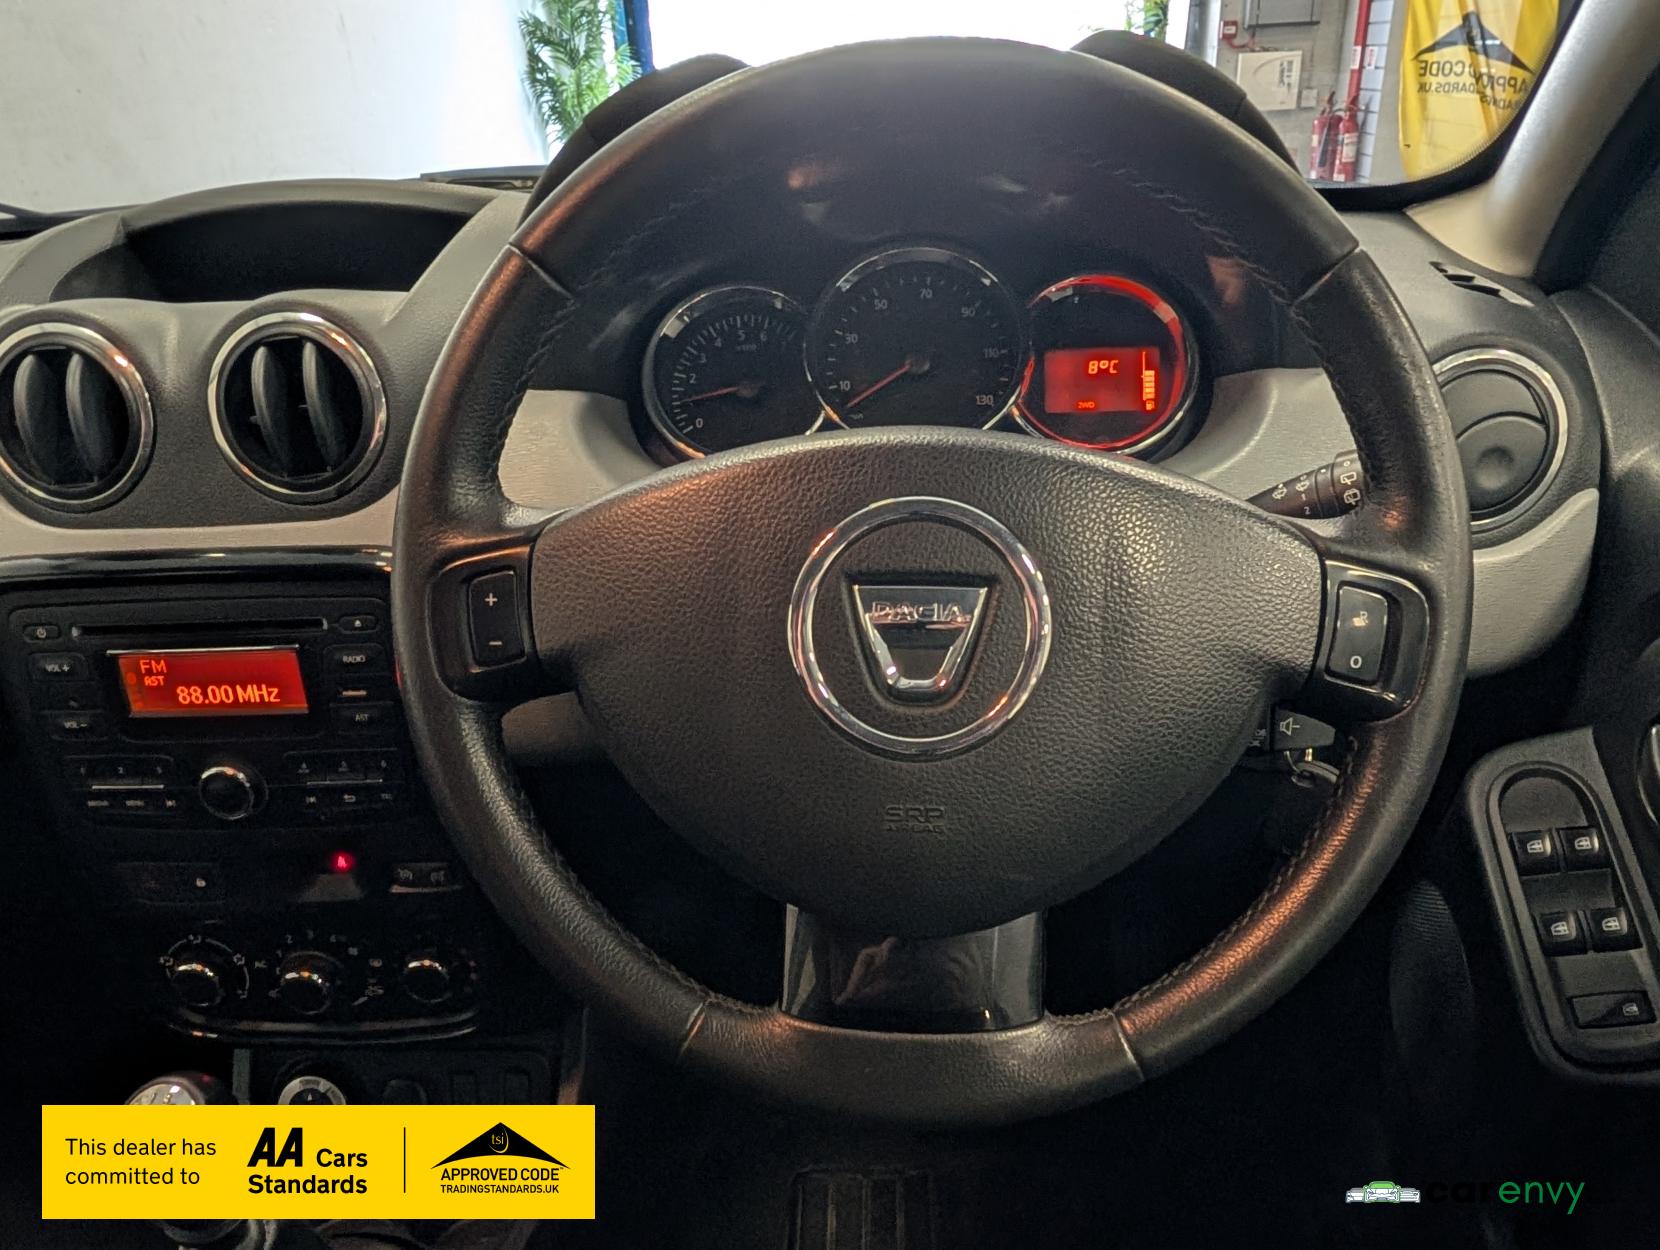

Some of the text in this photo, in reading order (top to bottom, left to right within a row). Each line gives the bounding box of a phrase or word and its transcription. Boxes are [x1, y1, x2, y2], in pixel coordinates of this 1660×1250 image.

[874, 299, 888, 310] 50
[961, 307, 975, 318] 90
[840, 380, 850, 391] 10
[975, 394, 994, 406] 130
[871, 601, 970, 624] DACIA
[342, 654, 366, 664] RADIO
[139, 659, 167, 674] FM
[176, 683, 281, 704] 88.00 MHz
